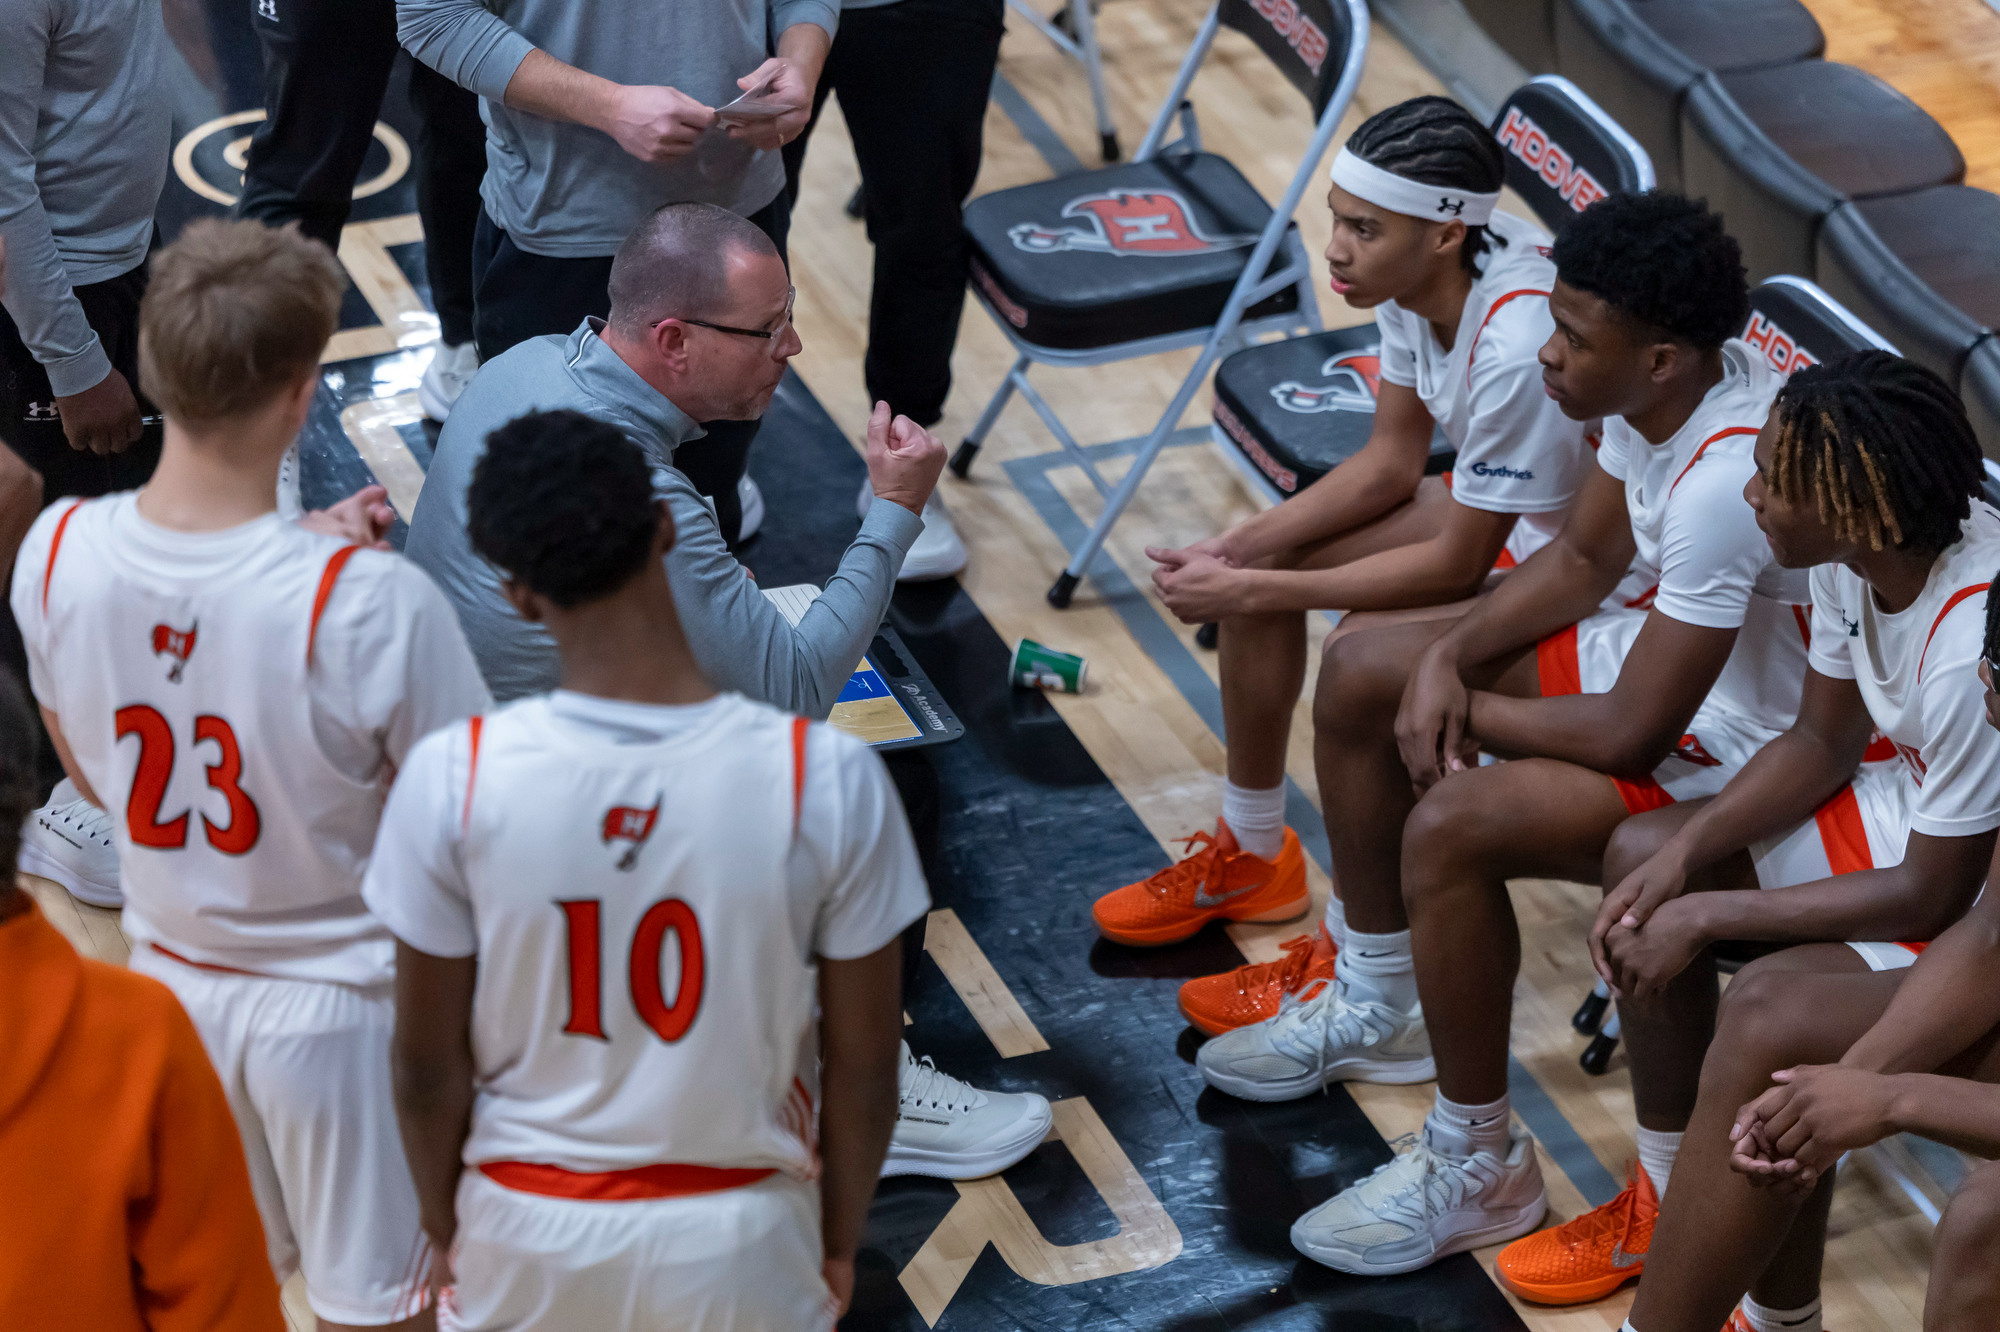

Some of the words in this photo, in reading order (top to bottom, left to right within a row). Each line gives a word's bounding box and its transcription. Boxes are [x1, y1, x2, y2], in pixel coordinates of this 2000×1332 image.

[1249, 0, 1329, 76] OOVER
[1495, 104, 1609, 213] HOOVE
[1472, 462, 1534, 480] Guthrie's
[914, 695, 947, 731] Academy
[115, 704, 261, 855] 23
[552, 897, 706, 1043] 10
